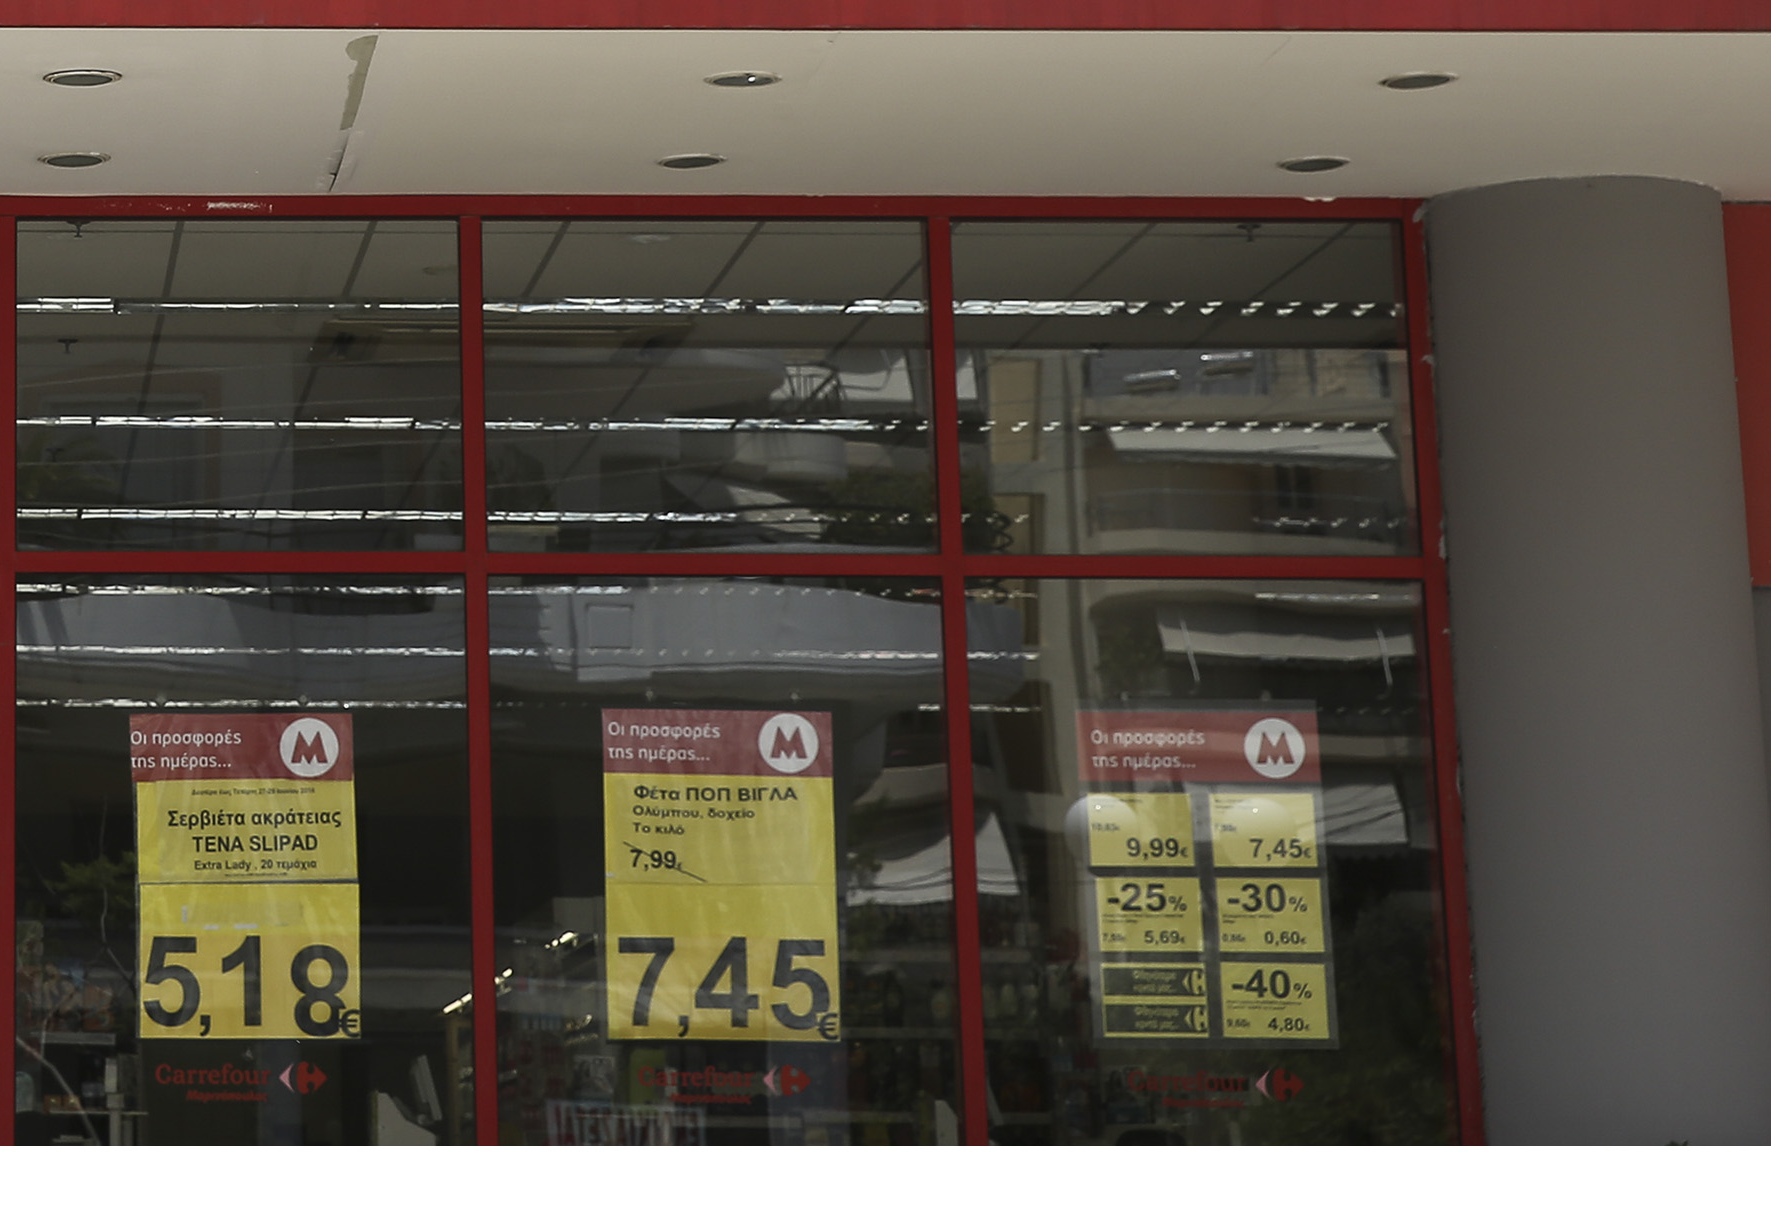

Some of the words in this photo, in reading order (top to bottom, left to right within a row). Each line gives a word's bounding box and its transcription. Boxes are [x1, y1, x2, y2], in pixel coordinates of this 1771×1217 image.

[130, 730, 148, 746] Οι
[152, 730, 242, 748] προσφορές
[607, 721, 626, 737] Οι
[629, 721, 721, 742] προσφορές
[1091, 729, 1109, 746] Οι
[1113, 729, 1206, 749] προσφορές
[130, 754, 156, 769] της
[607, 746, 635, 761] της
[1091, 755, 1119, 769] της
[634, 785, 680, 801] Φέτα
[686, 787, 731, 802] ΠΟΠ
[737, 787, 798, 802] ΒΙΓΛΑ
[167, 809, 245, 830] Σερβιέτα
[251, 808, 341, 829] ακράτειας
[708, 806, 756, 821] δοχείο
[632, 822, 651, 835] Το
[654, 822, 685, 836] κιλό
[192, 836, 244, 853] TENA
[249, 835, 318, 852] SLIPAD
[194, 860, 222, 871] Extra
[225, 860, 252, 872] Lady
[261, 859, 274, 869] 20
[276, 859, 317, 871] τεμάχια
[1107, 882, 1188, 912] -25%
[1227, 882, 1308, 913] -30%
[1232, 968, 1312, 999] -40%
[154, 1062, 271, 1085] Carrefour
[637, 1064, 756, 1088] Carrefour
[1127, 1068, 1248, 1092] Carrefour
